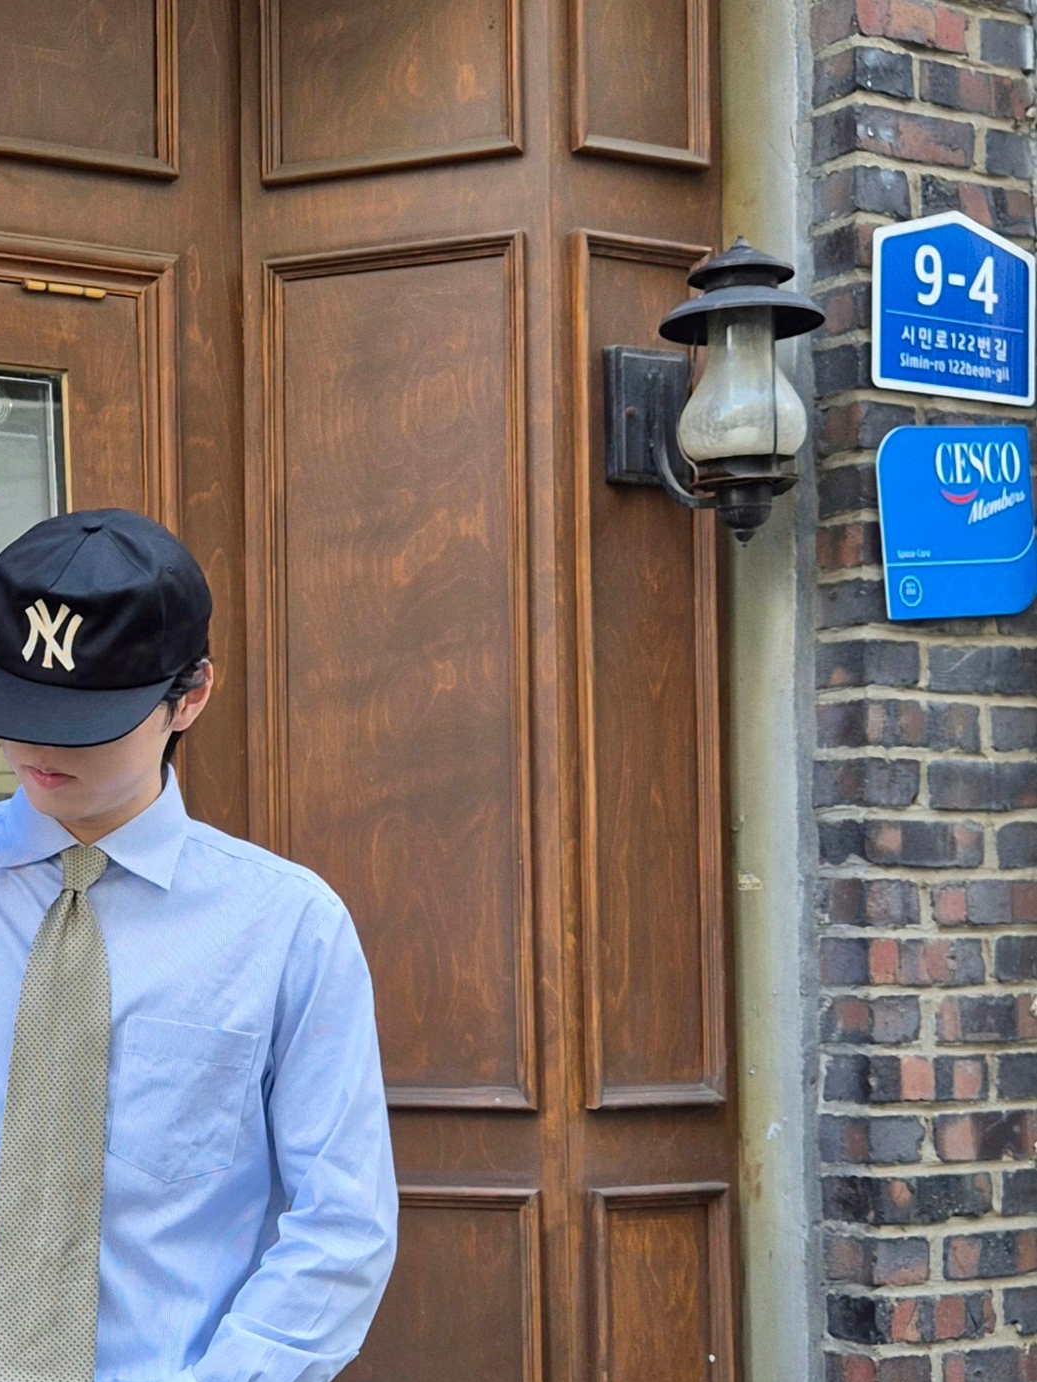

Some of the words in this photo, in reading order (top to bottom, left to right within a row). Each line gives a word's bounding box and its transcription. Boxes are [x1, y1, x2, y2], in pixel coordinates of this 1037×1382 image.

[914, 244, 999, 315] 9-4
[900, 325, 1008, 362] 시민로122번길
[899, 352, 946, 373] Simin-ro
[948, 358, 1010, 383] 122beon-gil
[934, 441, 1021, 485] CESCO
[967, 486, 1026, 526] Members
[21, 598, 84, 672] NY
